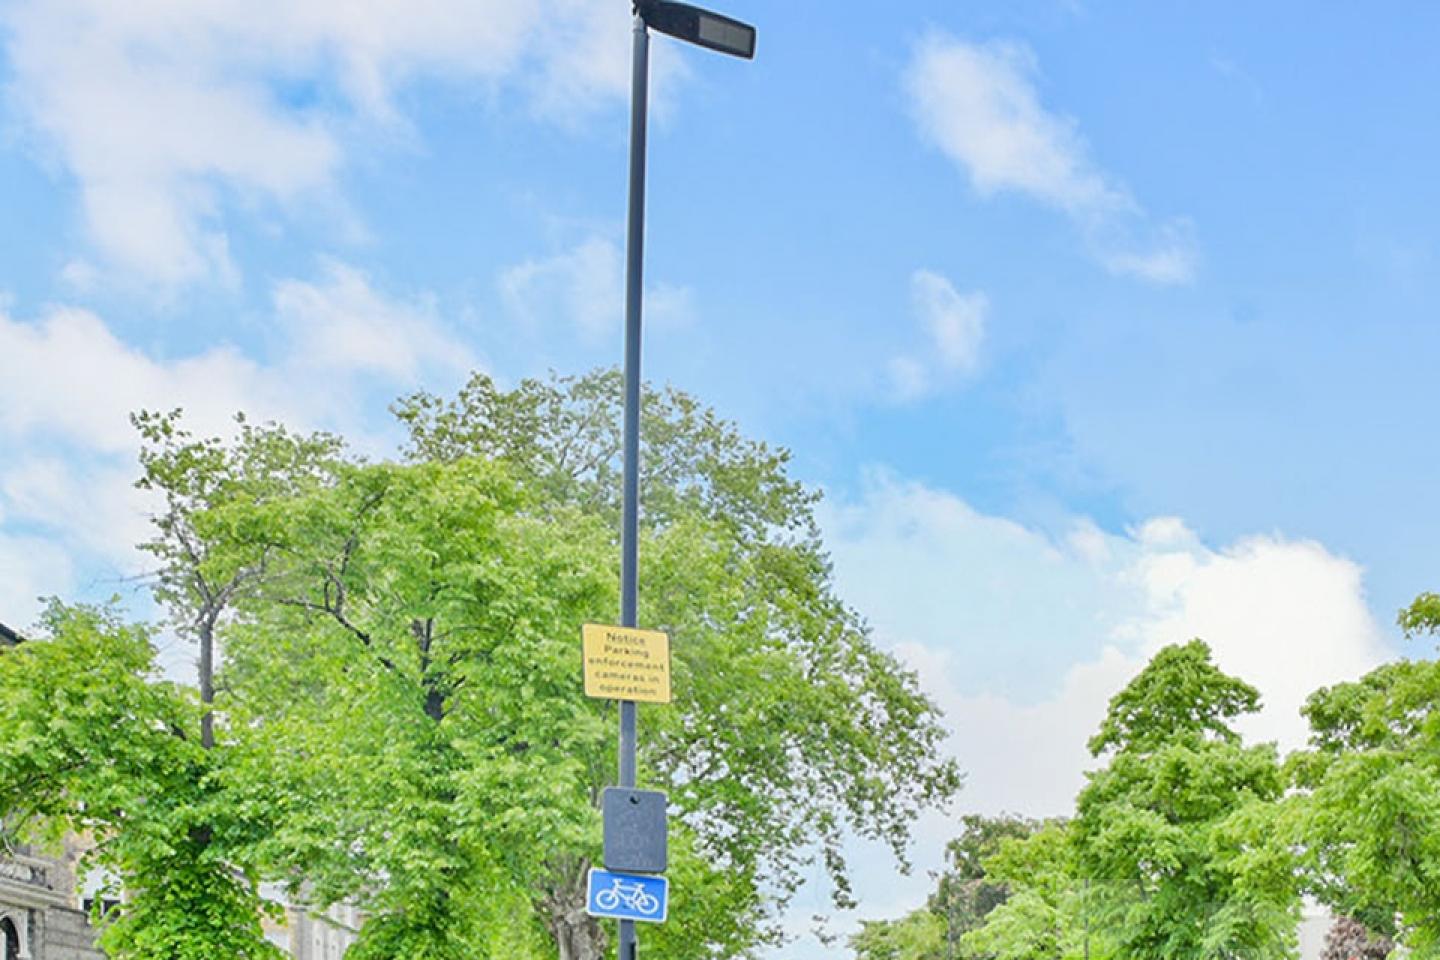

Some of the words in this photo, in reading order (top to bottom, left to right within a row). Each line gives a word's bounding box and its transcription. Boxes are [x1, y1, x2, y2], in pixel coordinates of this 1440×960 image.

[606, 632, 645, 645] Notice
[603, 644, 649, 659] Parking
[588, 657, 664, 672] enforcement
